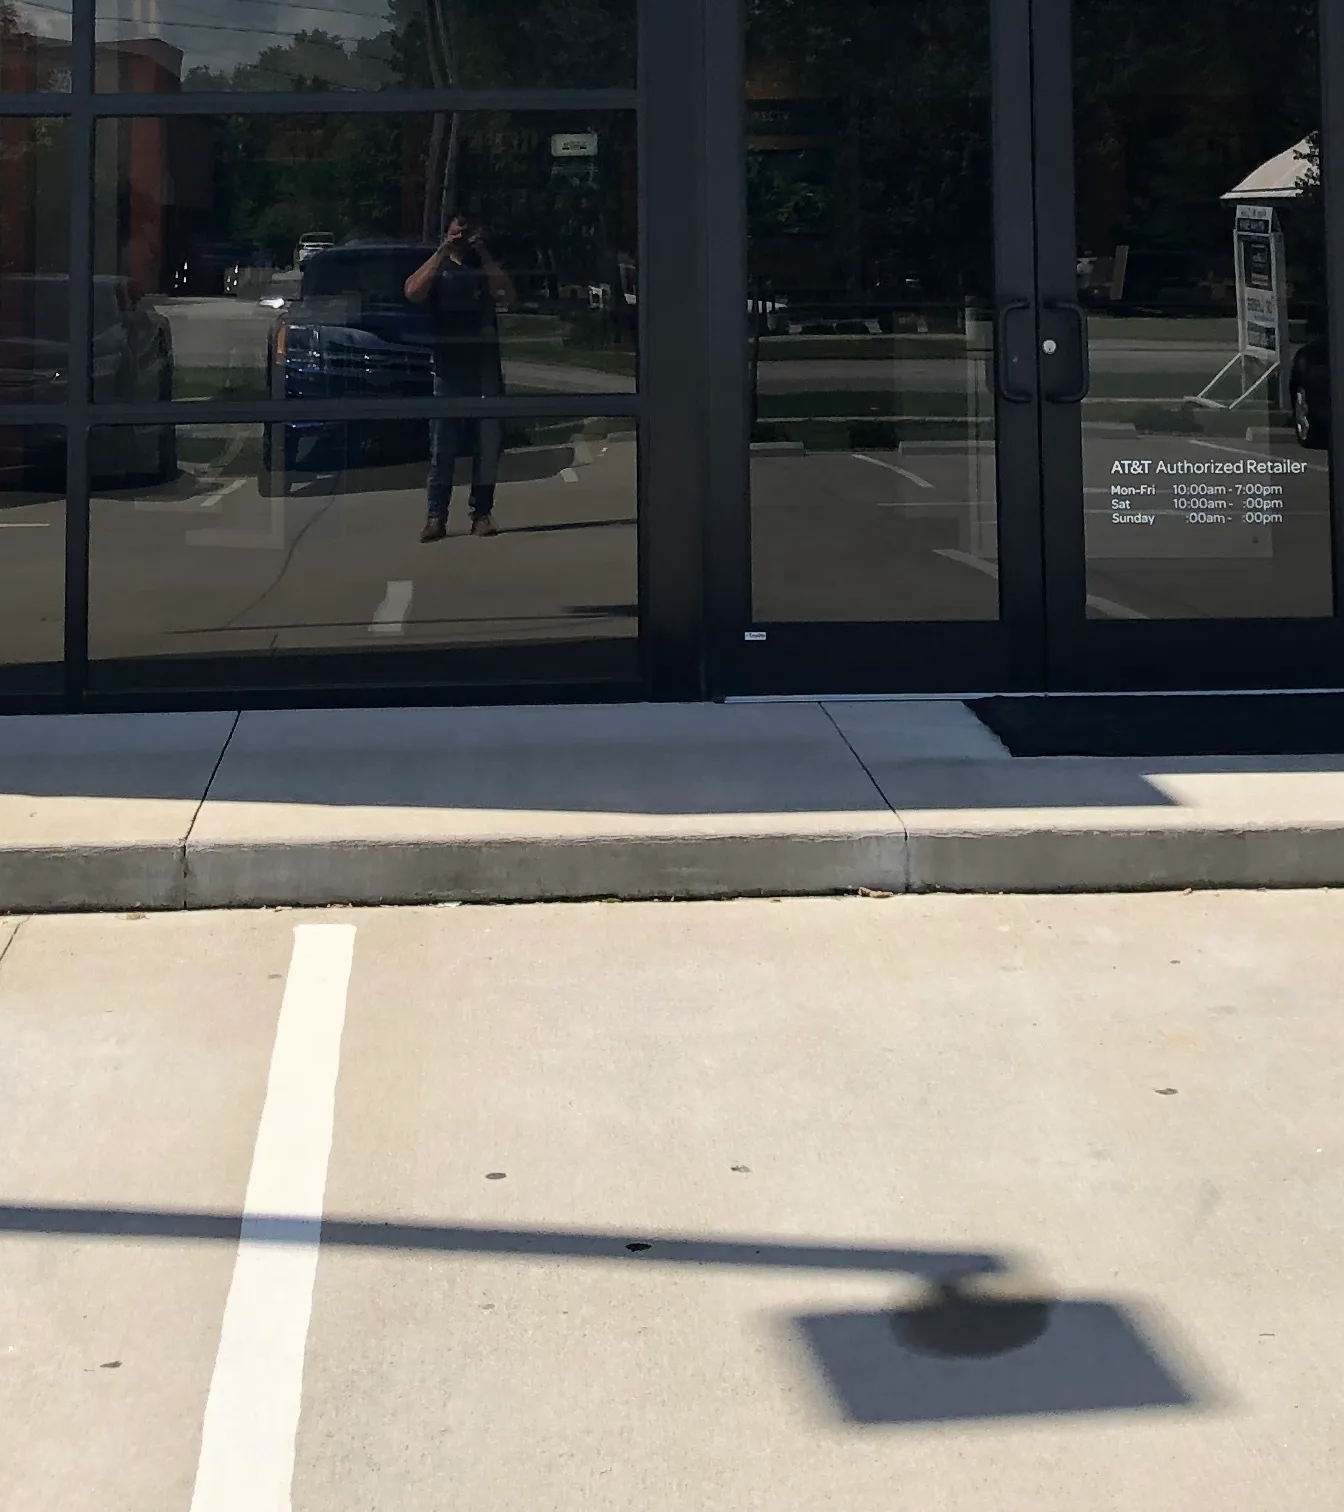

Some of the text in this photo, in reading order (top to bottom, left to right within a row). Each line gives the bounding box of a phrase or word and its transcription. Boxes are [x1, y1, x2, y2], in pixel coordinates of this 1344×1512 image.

[1110, 458, 1309, 475] AT&T Authorized Retailer
[1110, 483, 1156, 496] Mon-Fri
[1172, 483, 1227, 495] 10:00am
[1234, 483, 1283, 497] 7:00pm
[1111, 498, 1131, 510] Sat
[1172, 497, 1227, 509] 10:00am
[1111, 512, 1156, 525] Sunday
